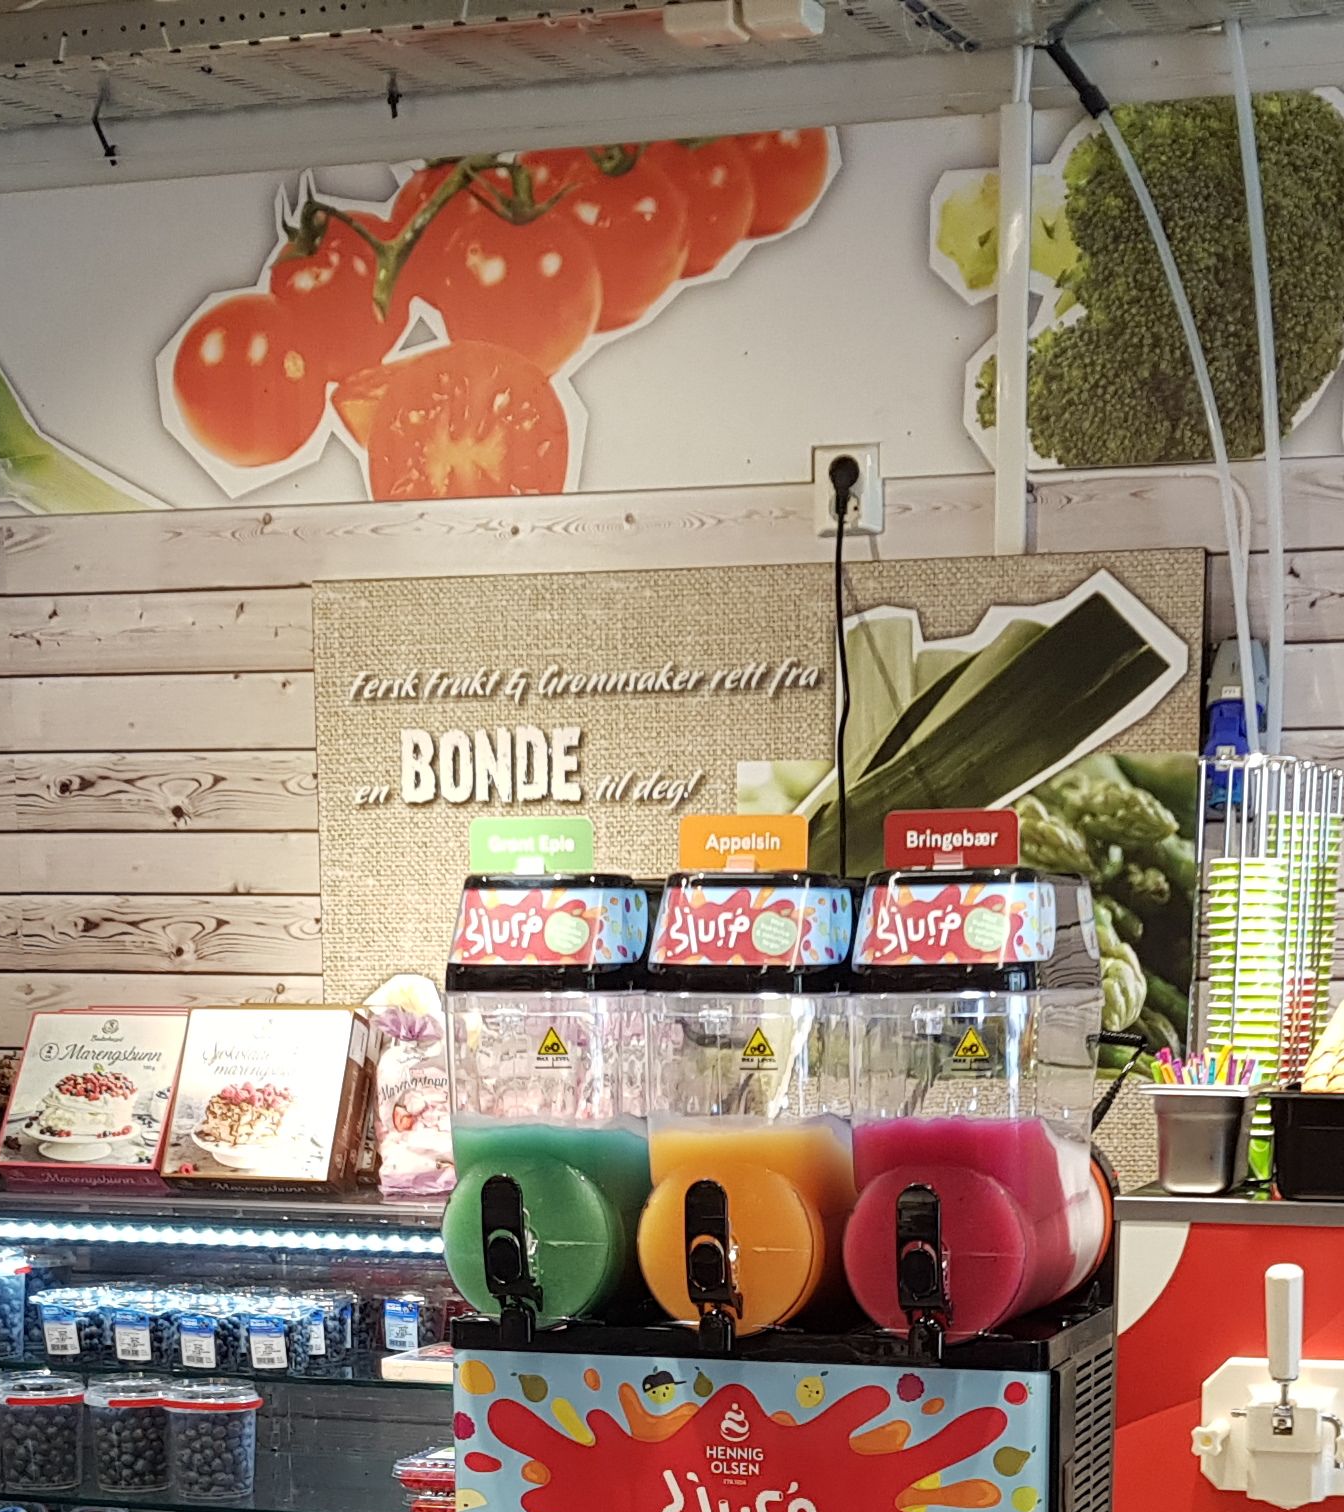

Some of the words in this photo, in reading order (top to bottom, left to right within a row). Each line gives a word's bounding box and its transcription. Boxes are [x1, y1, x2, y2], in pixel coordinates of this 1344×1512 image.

[348, 668, 418, 700] Fersk
[423, 667, 500, 698] Frukt
[710, 661, 766, 690] rett
[768, 657, 819, 698] fra
[356, 784, 390, 804] en
[400, 726, 581, 804] BONDE
[596, 769, 633, 801] til
[633, 769, 703, 808] deg!
[705, 832, 781, 854] Appelsin
[906, 828, 998, 851] Bringebær
[58, 1044, 162, 1066] Marengsbunn
[706, 1445, 764, 1461] HENNIG
[710, 1461, 760, 1475] OLSEN
